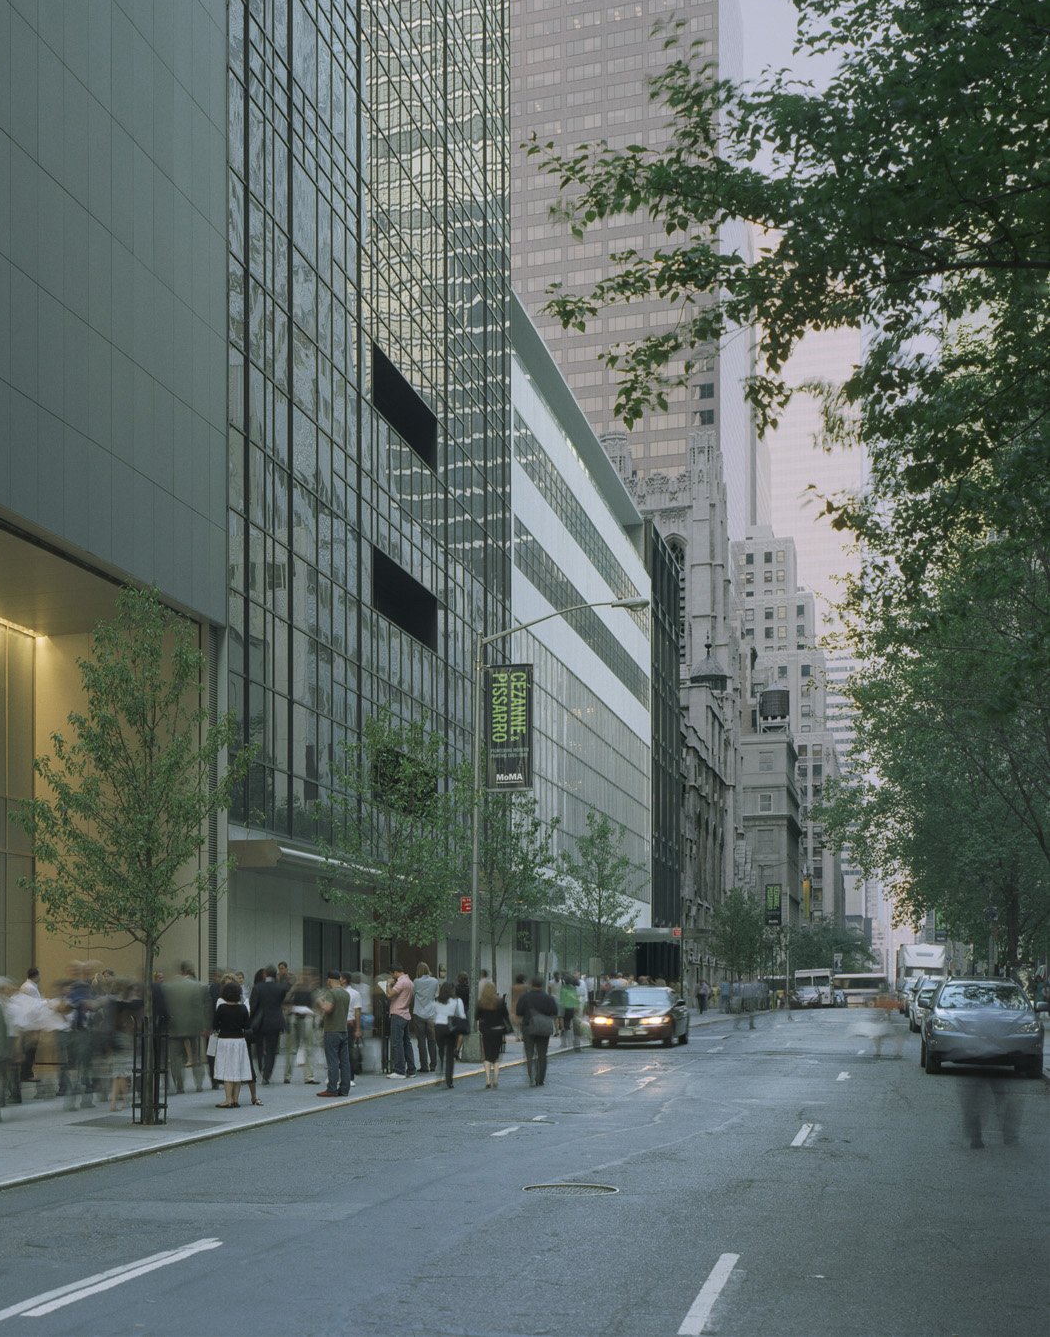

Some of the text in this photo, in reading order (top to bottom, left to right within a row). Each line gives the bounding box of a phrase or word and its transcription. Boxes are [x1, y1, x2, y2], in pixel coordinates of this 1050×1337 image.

[492, 673, 508, 742] PISSARRO
[510, 671, 531, 734] CÉZANNE
[496, 773, 523, 781] MoMA
